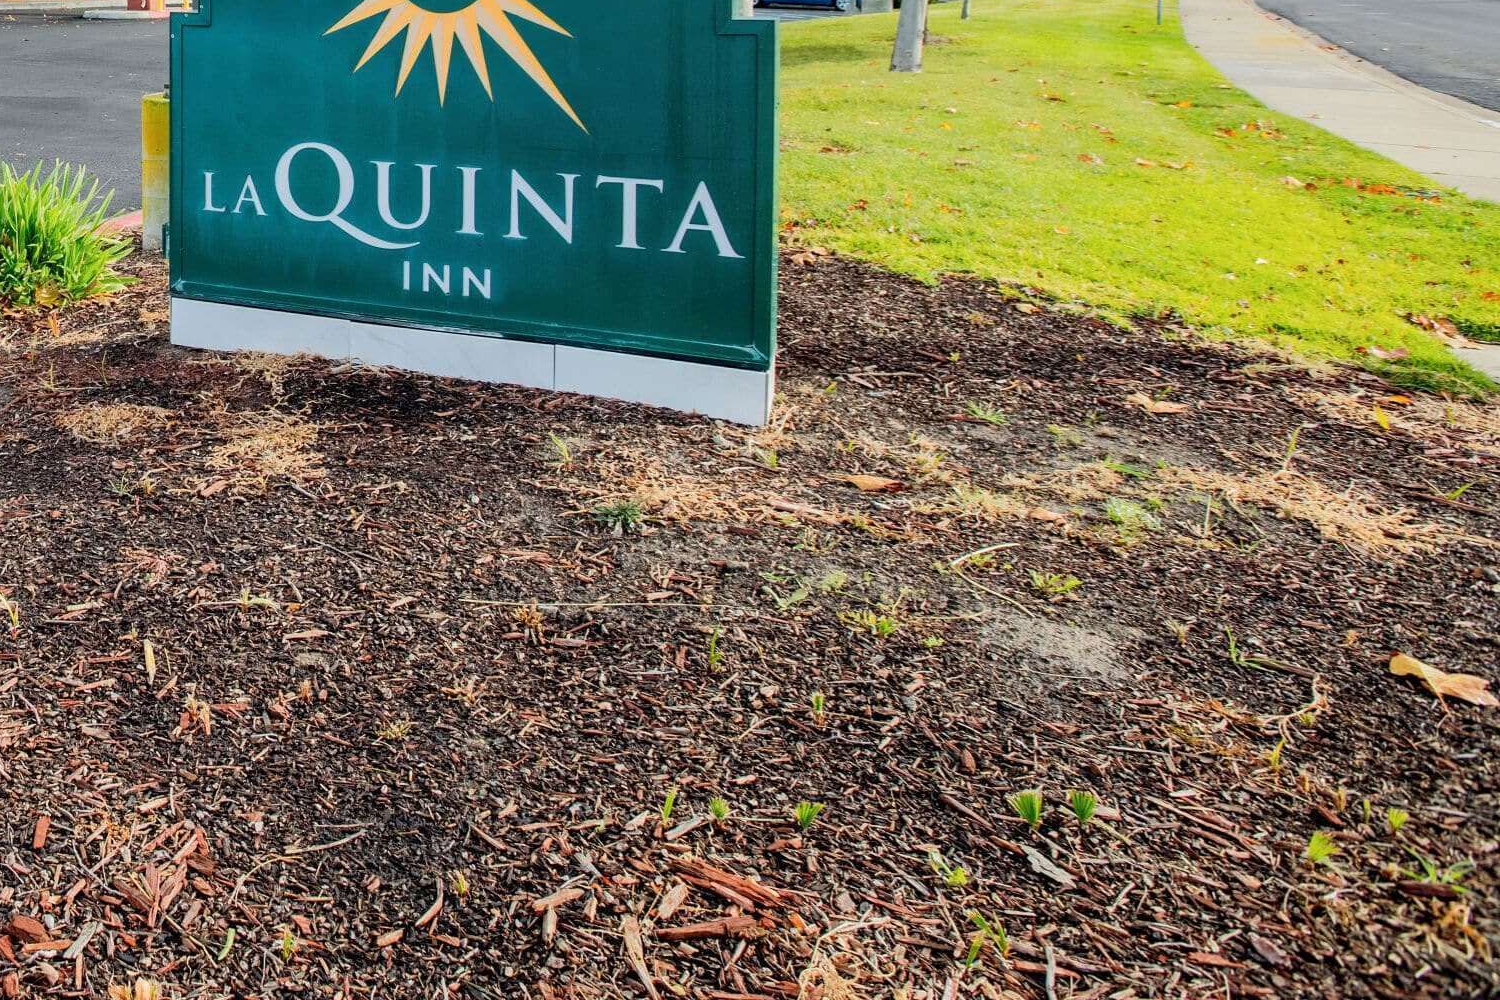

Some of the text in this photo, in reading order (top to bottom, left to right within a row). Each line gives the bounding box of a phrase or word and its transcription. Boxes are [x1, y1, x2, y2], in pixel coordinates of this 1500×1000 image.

[202, 142, 746, 259] LA QUINTA
[403, 260, 492, 300] INN
